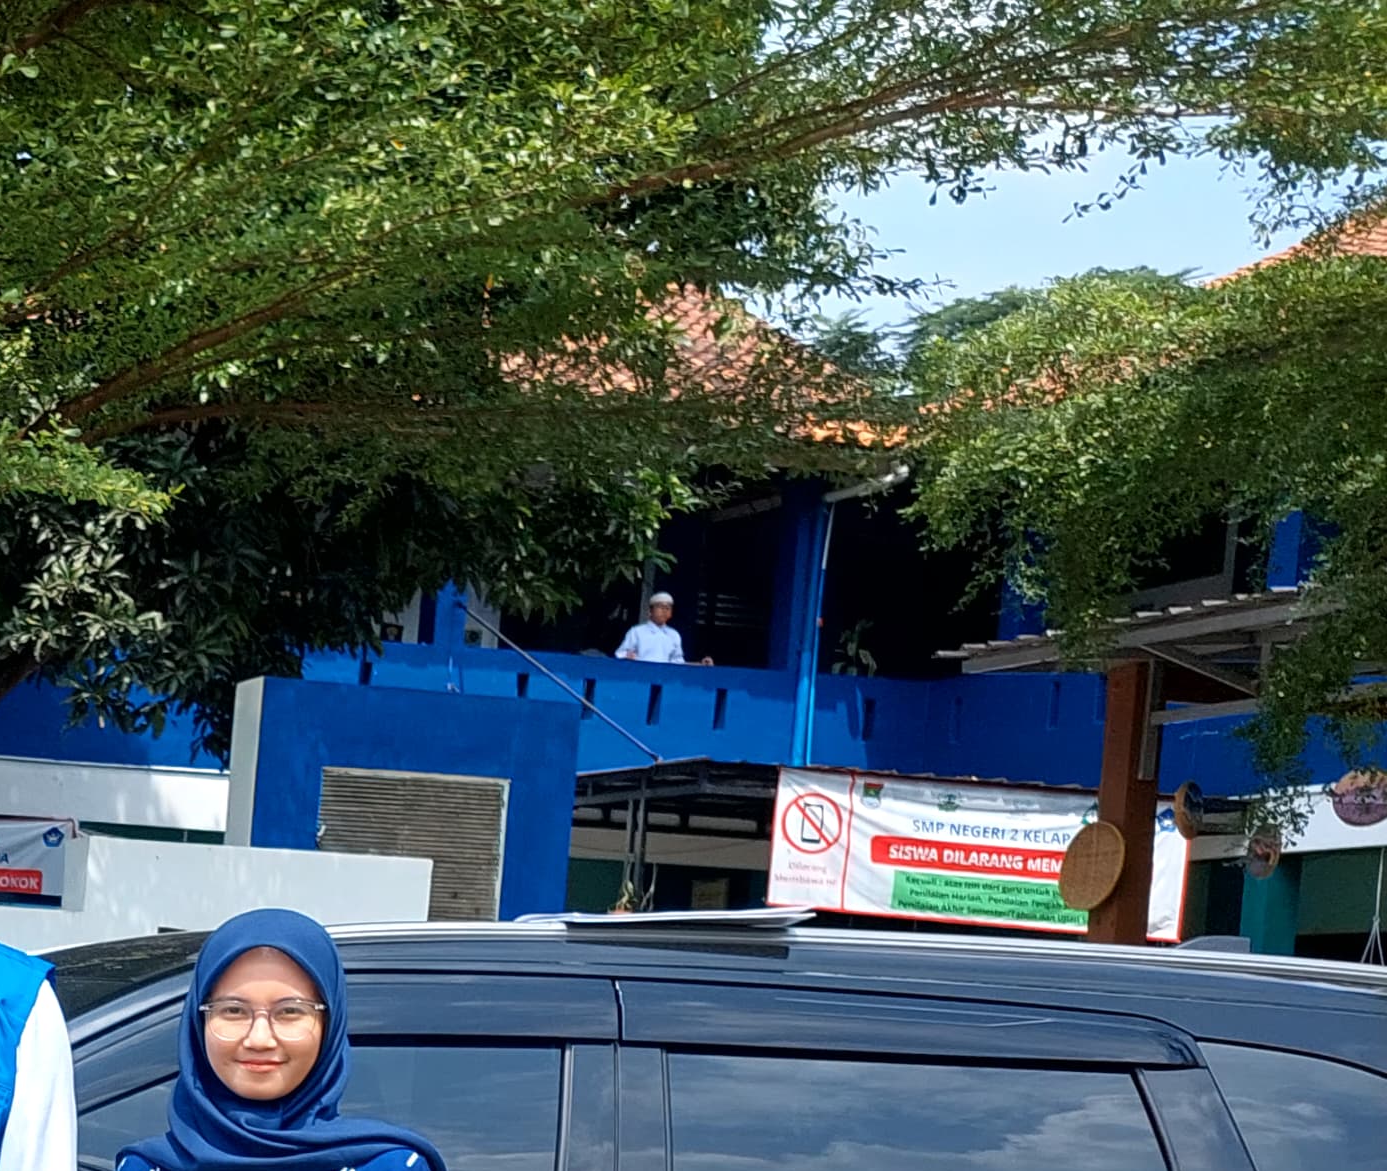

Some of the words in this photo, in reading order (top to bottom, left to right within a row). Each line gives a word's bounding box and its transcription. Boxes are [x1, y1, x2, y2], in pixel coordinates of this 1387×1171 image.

[913, 819, 945, 834] SMP
[949, 823, 1006, 840] NEGERI
[1009, 828, 1019, 842] 2
[1023, 830, 1071, 846] KELAP
[888, 844, 938, 862] SISWA
[942, 849, 1024, 870] DILARANG
